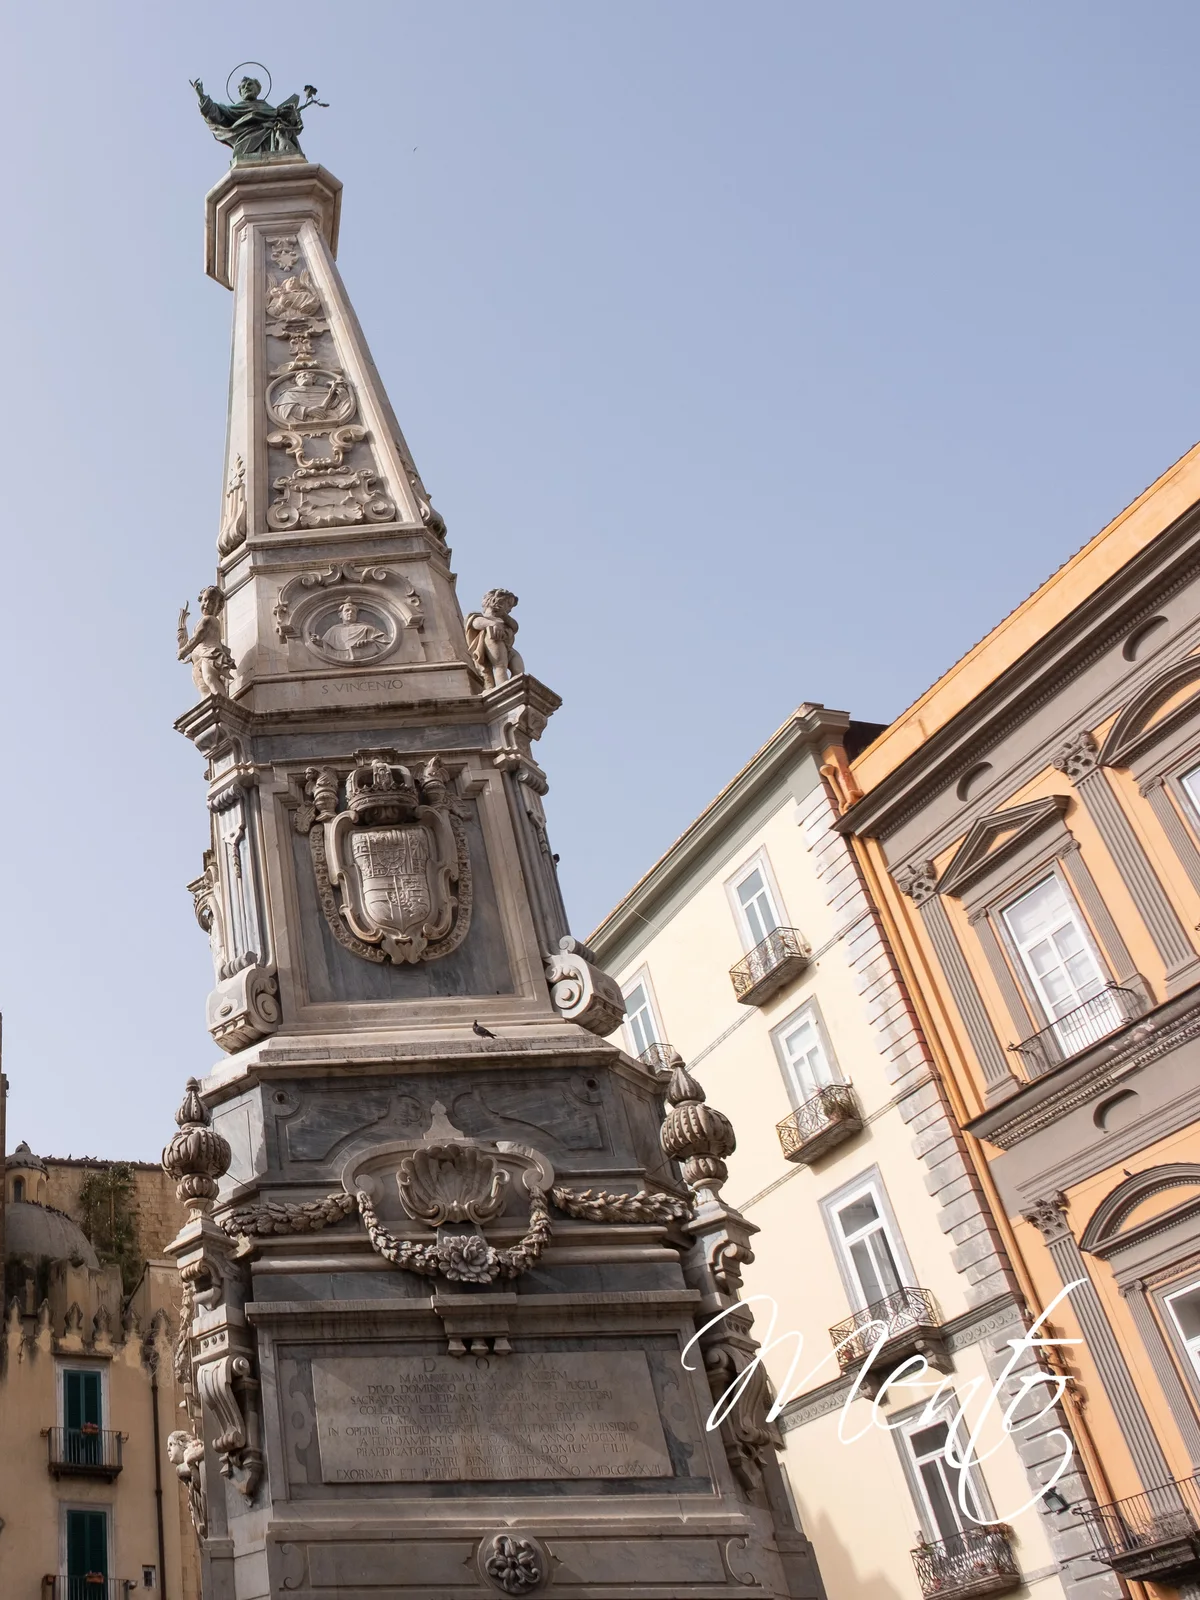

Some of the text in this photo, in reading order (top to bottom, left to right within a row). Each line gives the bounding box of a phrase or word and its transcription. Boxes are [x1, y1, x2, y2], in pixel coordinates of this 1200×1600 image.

[321, 679, 404, 695] S VINCENZO
[368, 1385, 395, 1394] DIVO
[400, 1383, 457, 1394] DOMINICO
[359, 1405, 411, 1415] COLLATO
[419, 1404, 452, 1414] SEMEL
[328, 1427, 340, 1436] IN
[345, 1426, 380, 1436] OPERIS
[387, 1425, 430, 1436] INITIUM
[436, 1424, 480, 1434] VIGINTI
[588, 1421, 639, 1432] SUBSIDIO
[372, 1435, 454, 1446] FUNDAMENTIS
[540, 1433, 575, 1443] ANNO
[541, 1443, 589, 1454] DOMUS
[429, 1456, 459, 1467] PATRI
[336, 1468, 394, 1480] EXORNARI
[400, 1468, 417, 1479] ET
[543, 1465, 581, 1477] ANNO
